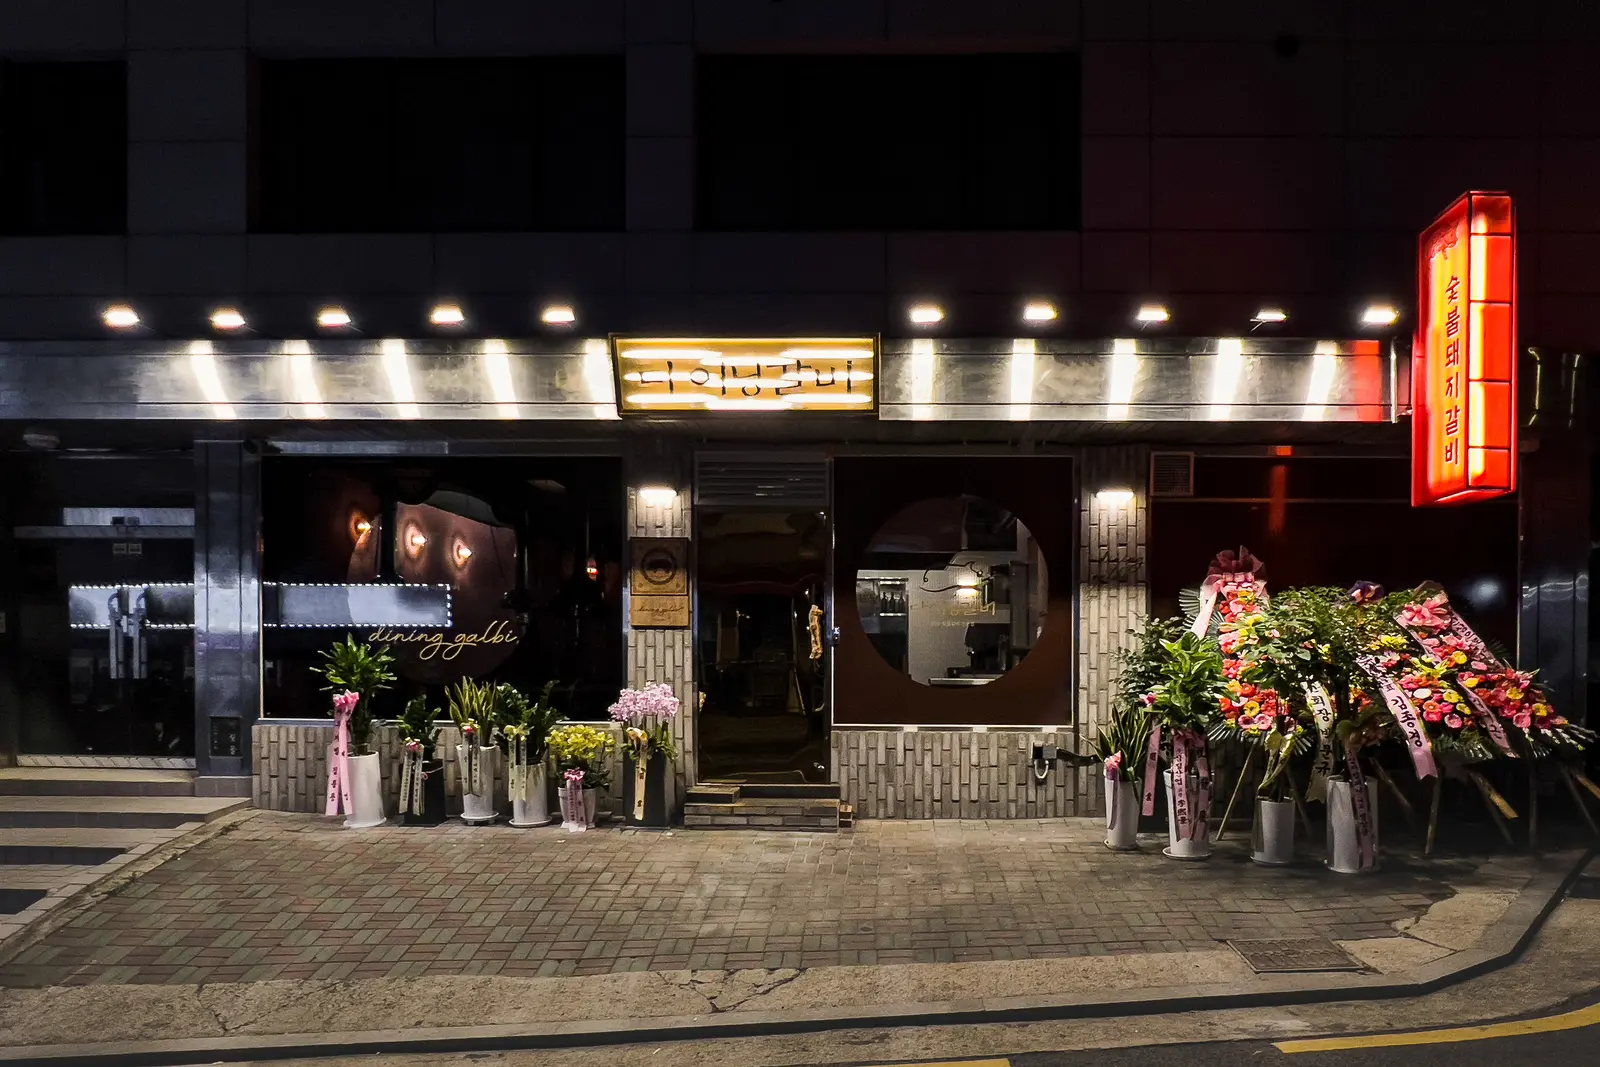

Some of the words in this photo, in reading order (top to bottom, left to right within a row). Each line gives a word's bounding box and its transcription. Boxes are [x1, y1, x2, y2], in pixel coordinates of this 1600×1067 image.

[1442, 275, 1461, 465] 숯불돼지갈비
[368, 626, 444, 661] dining
[443, 619, 519, 661] galbi
